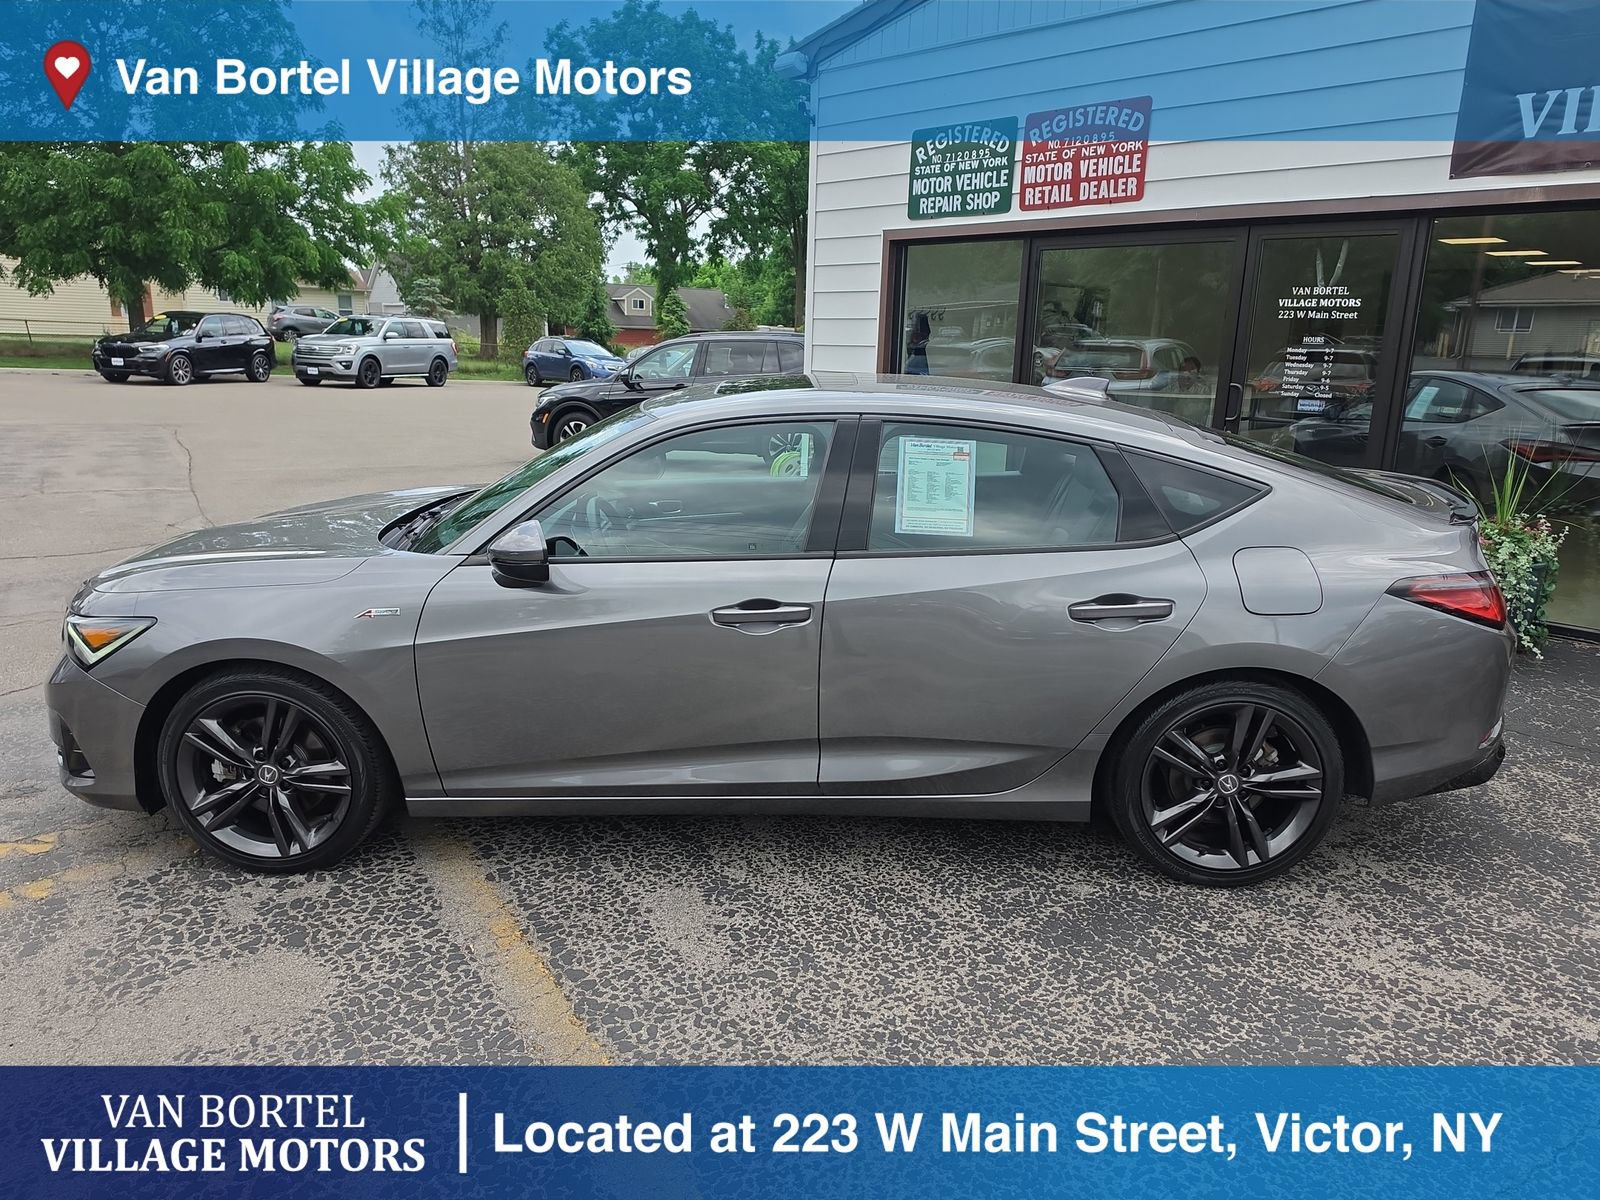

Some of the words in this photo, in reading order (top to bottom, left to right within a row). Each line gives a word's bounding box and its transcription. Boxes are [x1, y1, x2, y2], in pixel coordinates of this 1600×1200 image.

[1029, 105, 1145, 147] REGISTERED
[915, 124, 1010, 164] REGISTERED
[1063, 131, 1116, 147] 7120895
[945, 148, 991, 161] 7120895
[1025, 152, 1057, 163] STATE
[1062, 149, 1076, 160] OF
[1081, 145, 1106, 157] NEW
[1111, 141, 1143, 153] YORK
[914, 164, 941, 175] STATE
[943, 162, 956, 172] OF
[958, 160, 980, 171] NEW
[982, 156, 1009, 168] YORK
[1023, 162, 1073, 184] MOTOR
[1079, 153, 1142, 179] VEHICLE
[912, 176, 952, 196] MOTOR
[955, 170, 1009, 191] VEHICLE
[1024, 183, 1073, 206] RETAIL
[1079, 177, 1138, 200] DEALER
[919, 195, 962, 215] REPAIR
[965, 191, 1001, 211] SHOP
[1291, 286, 1311, 295] VAN
[1313, 286, 1350, 295] BORTEL
[1278, 298, 1318, 307] VILLAGE
[1319, 298, 1362, 307] MOTORS
[1278, 310, 1294, 319] 223
[1296, 310, 1306, 319] W
[1307, 310, 1329, 319] Main
[1330, 310, 1358, 319] Street
[1281, 383, 1305, 391] Saturday
